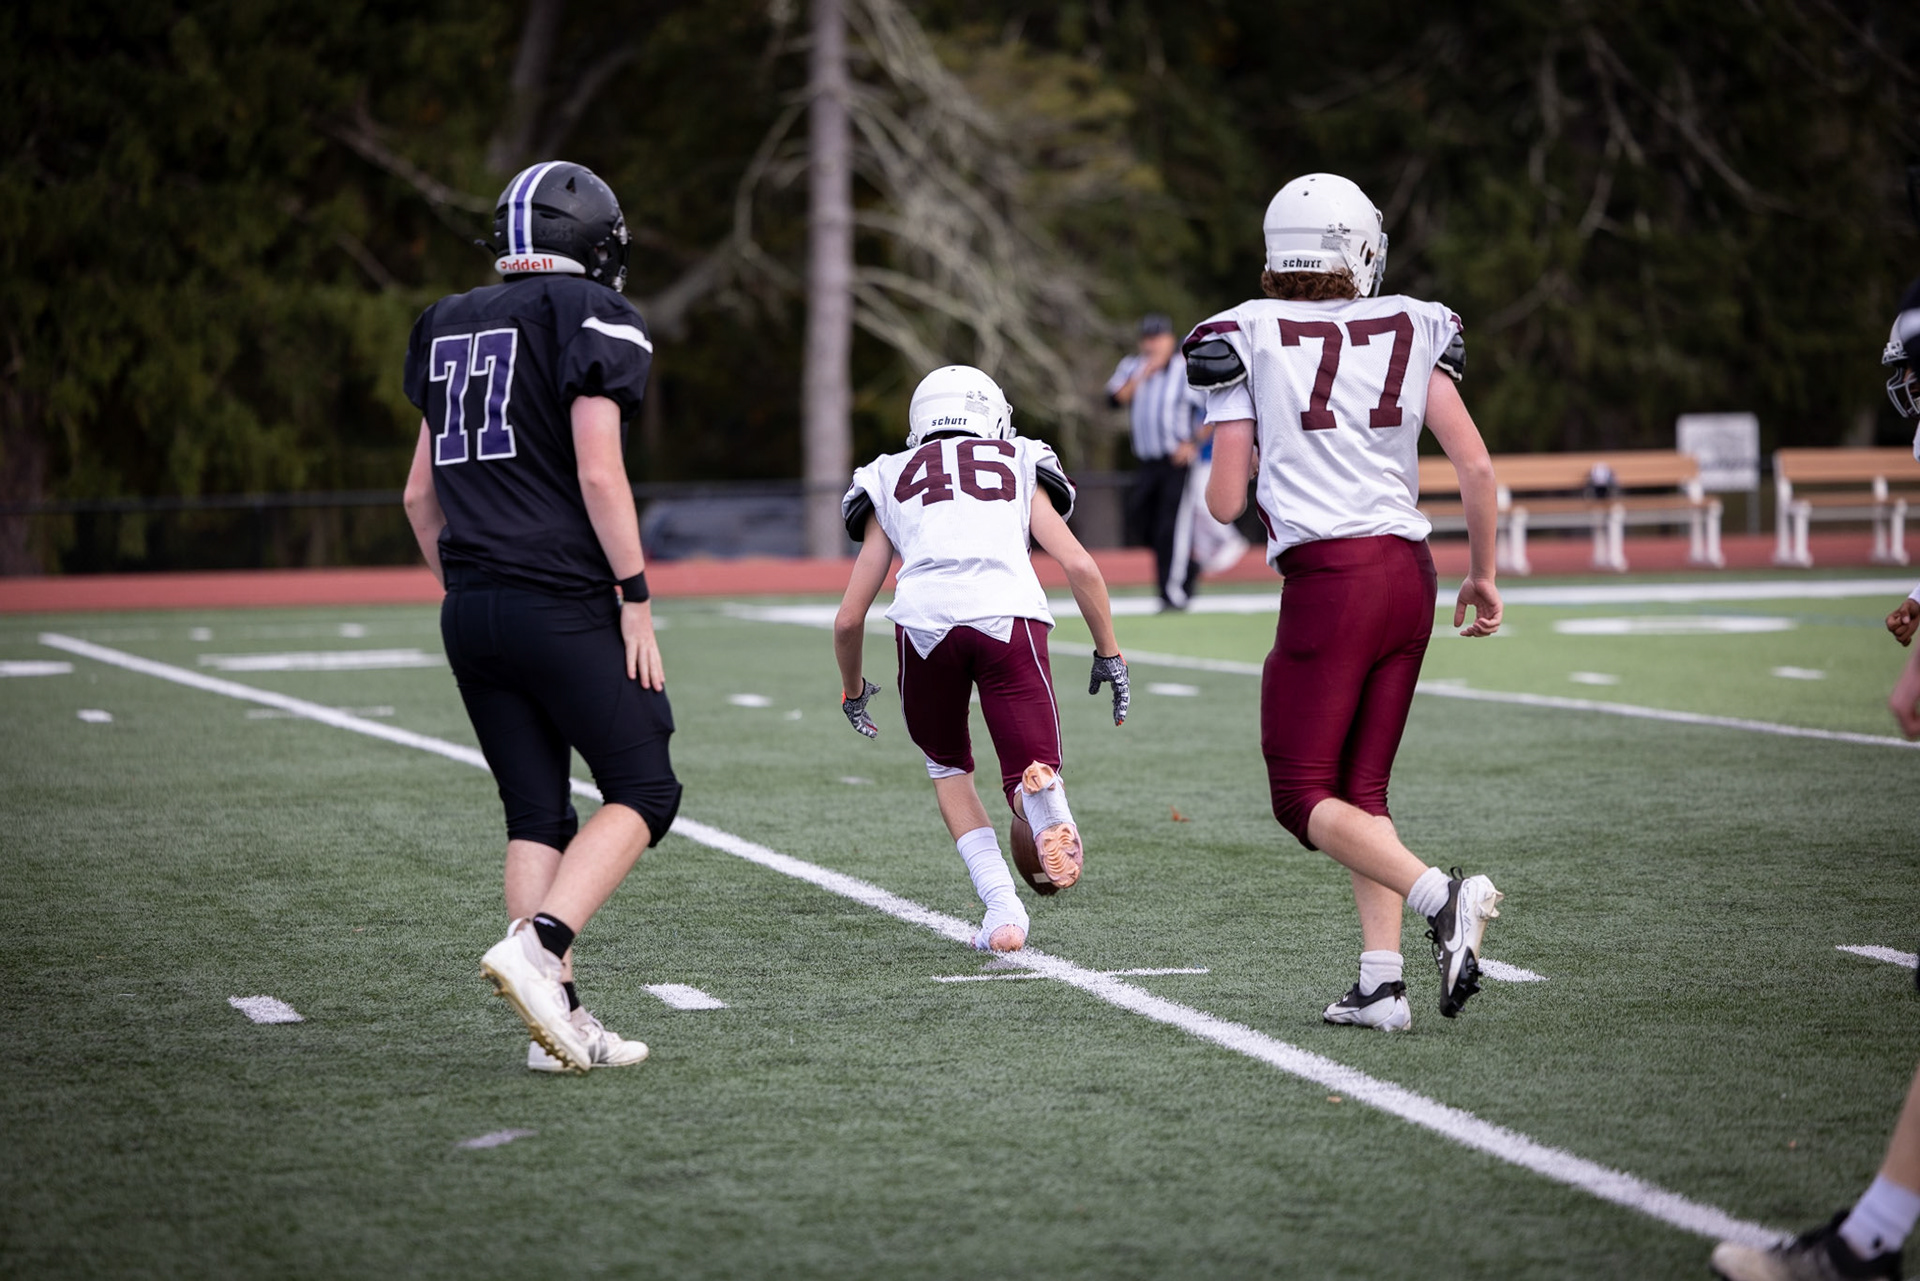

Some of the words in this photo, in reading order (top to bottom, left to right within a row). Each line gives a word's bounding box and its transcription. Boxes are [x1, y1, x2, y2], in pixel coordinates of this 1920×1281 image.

[1282, 257, 1322, 268] schutt
[429, 328, 518, 466] 77
[1277, 311, 1415, 431] 77
[931, 416, 968, 427] schutt
[893, 438, 1017, 507] 46
